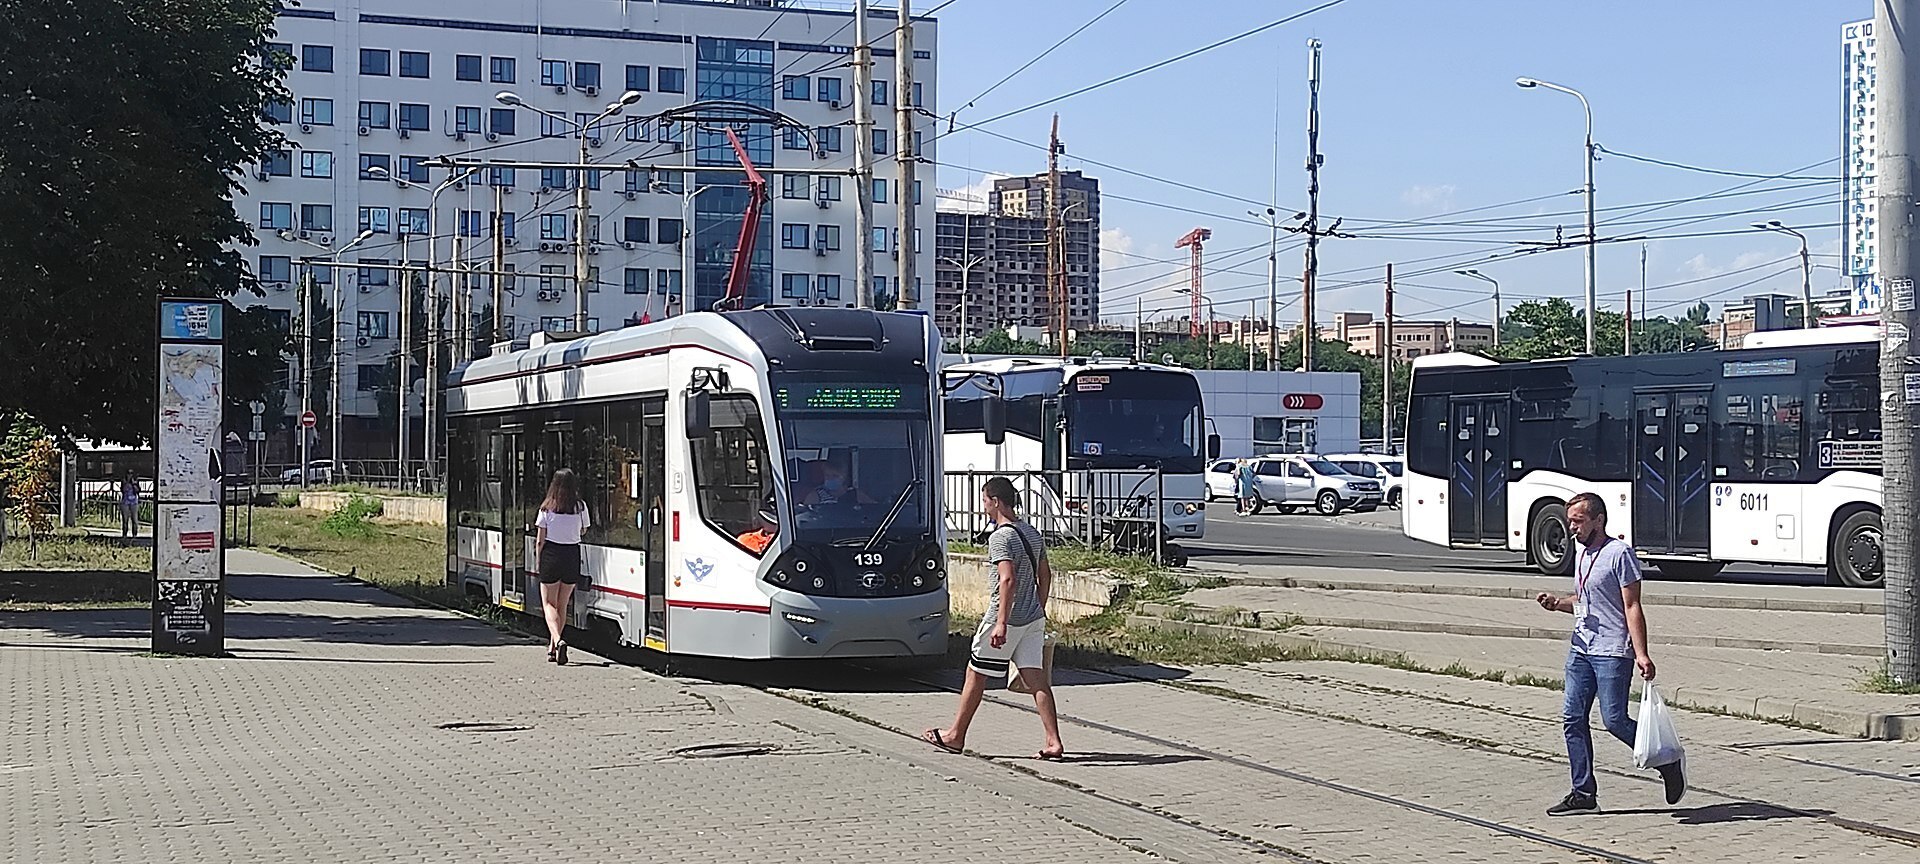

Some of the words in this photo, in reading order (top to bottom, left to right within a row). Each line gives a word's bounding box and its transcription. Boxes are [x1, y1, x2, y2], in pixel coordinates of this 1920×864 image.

[1862, 23, 1873, 37] 10
[1821, 446, 1831, 464] 3
[1740, 493, 1768, 511] 6011
[854, 553, 883, 566] 139
